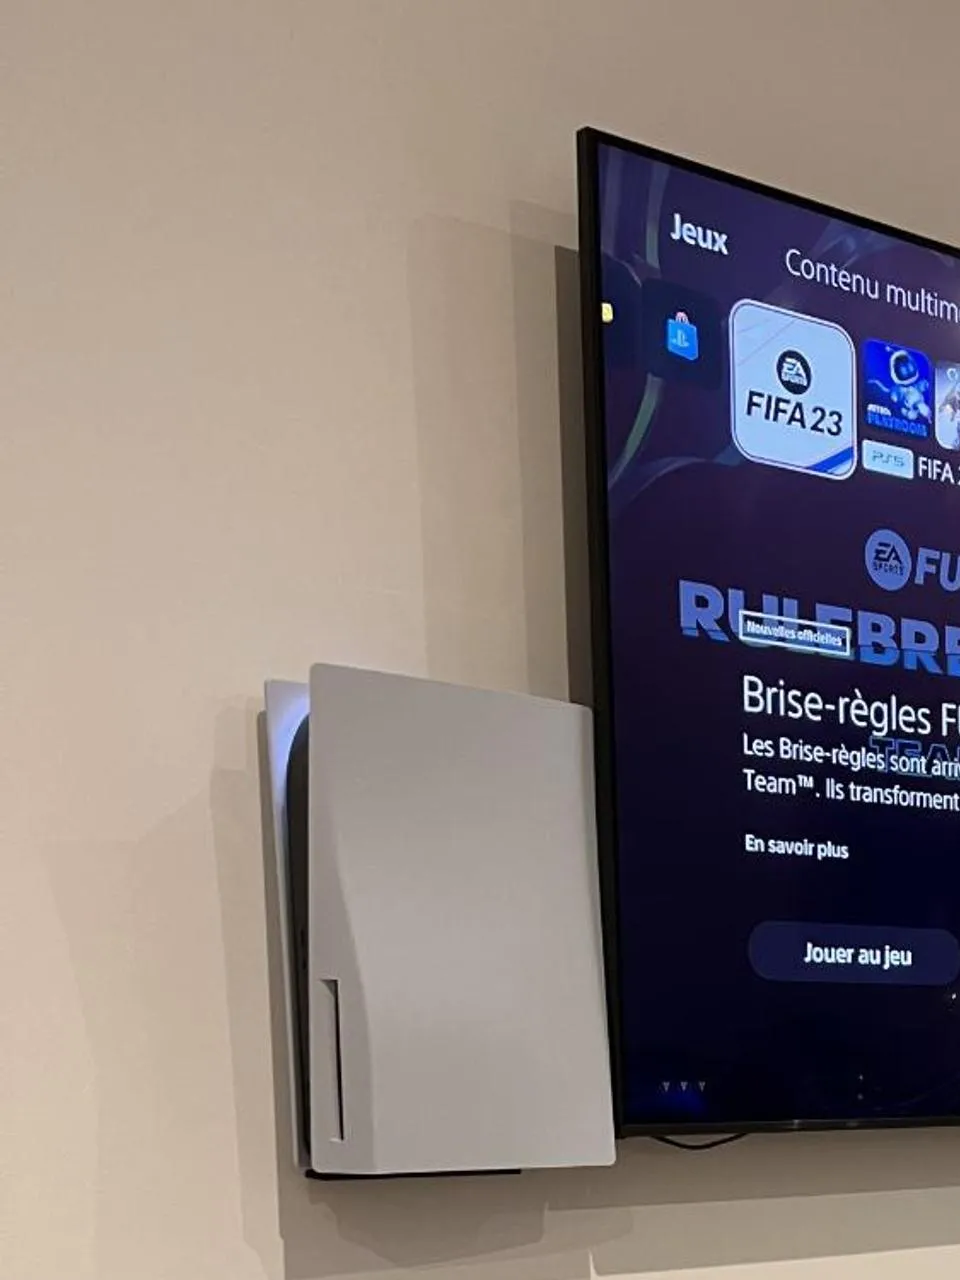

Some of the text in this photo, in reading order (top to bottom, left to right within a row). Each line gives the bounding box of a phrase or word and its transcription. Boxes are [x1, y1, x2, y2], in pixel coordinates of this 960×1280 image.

[670, 213, 729, 256] Jeux
[785, 248, 879, 299] Contenu
[746, 390, 843, 436] FIFA 23
[918, 456, 955, 485] FIFA
[874, 541, 902, 564] EA
[742, 675, 932, 737] Brise-règles
[742, 733, 774, 758] Les
[779, 737, 890, 772] Brise-règles
[890, 755, 927, 775] sont
[826, 777, 844, 800] Ils
[849, 781, 960, 812] transforment
[745, 833, 849, 860] En savoir plus
[803, 941, 913, 970] Jouer au jeu
